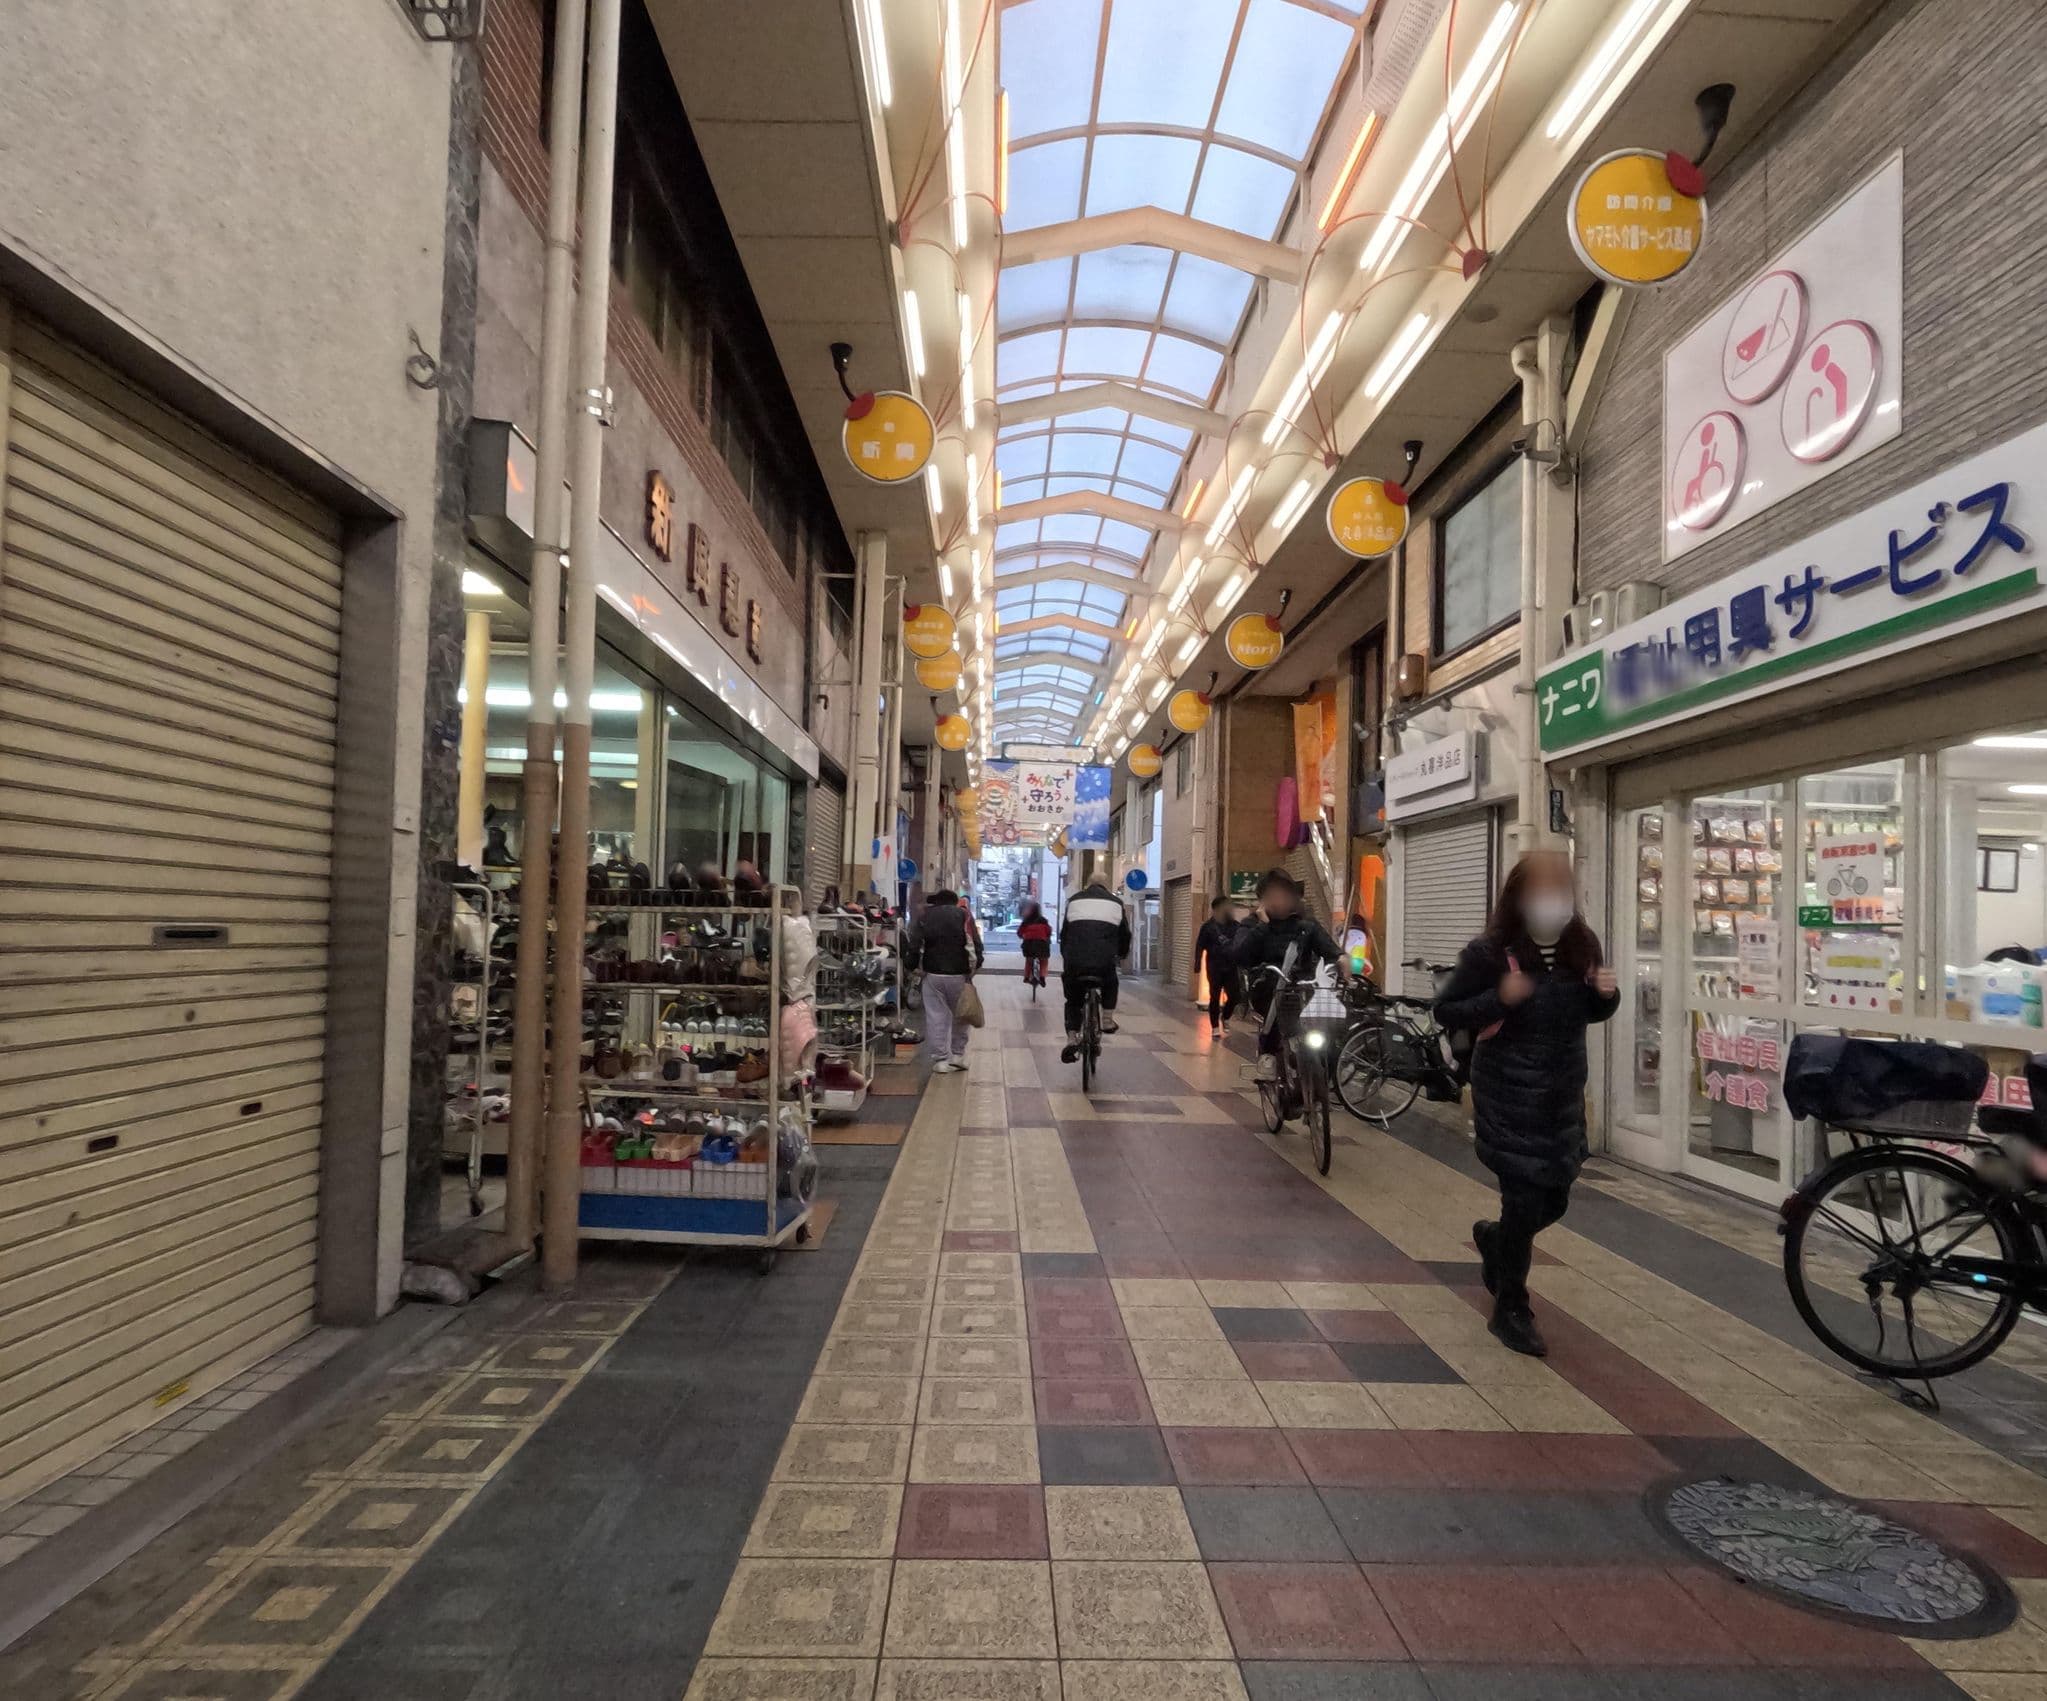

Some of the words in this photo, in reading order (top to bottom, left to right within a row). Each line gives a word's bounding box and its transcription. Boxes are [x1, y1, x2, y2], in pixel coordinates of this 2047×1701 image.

[1541, 668, 1602, 727] ナニワ
[1026, 773, 1065, 789] みんなで
[1027, 805, 1064, 814] おおさか
[1029, 789, 1062, 803] 守ろう
[1696, 1028, 1780, 1073] 福祉用具
[1706, 1071, 1769, 1113] 介護食
